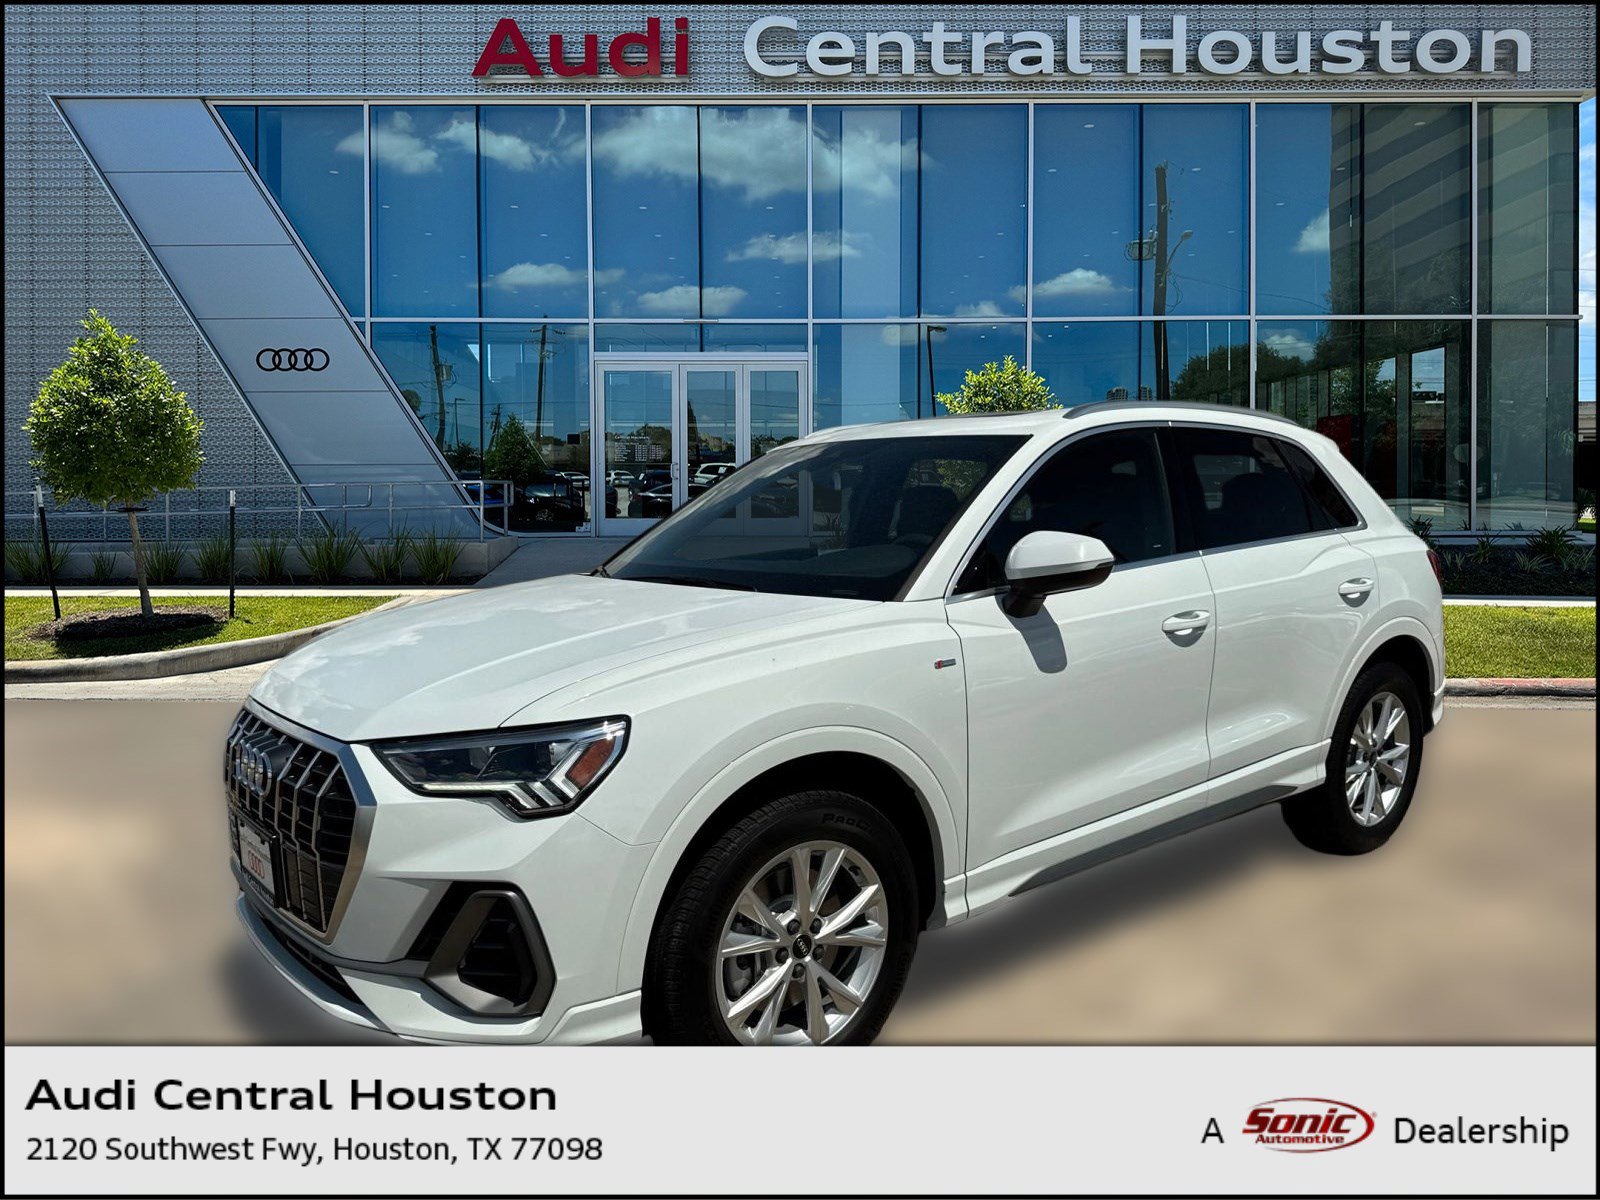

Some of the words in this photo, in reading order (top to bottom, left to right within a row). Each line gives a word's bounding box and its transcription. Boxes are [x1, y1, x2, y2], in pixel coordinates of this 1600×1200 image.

[471, 16, 690, 78] Audi
[743, 15, 1093, 77] Central
[1125, 14, 1532, 75] Houston
